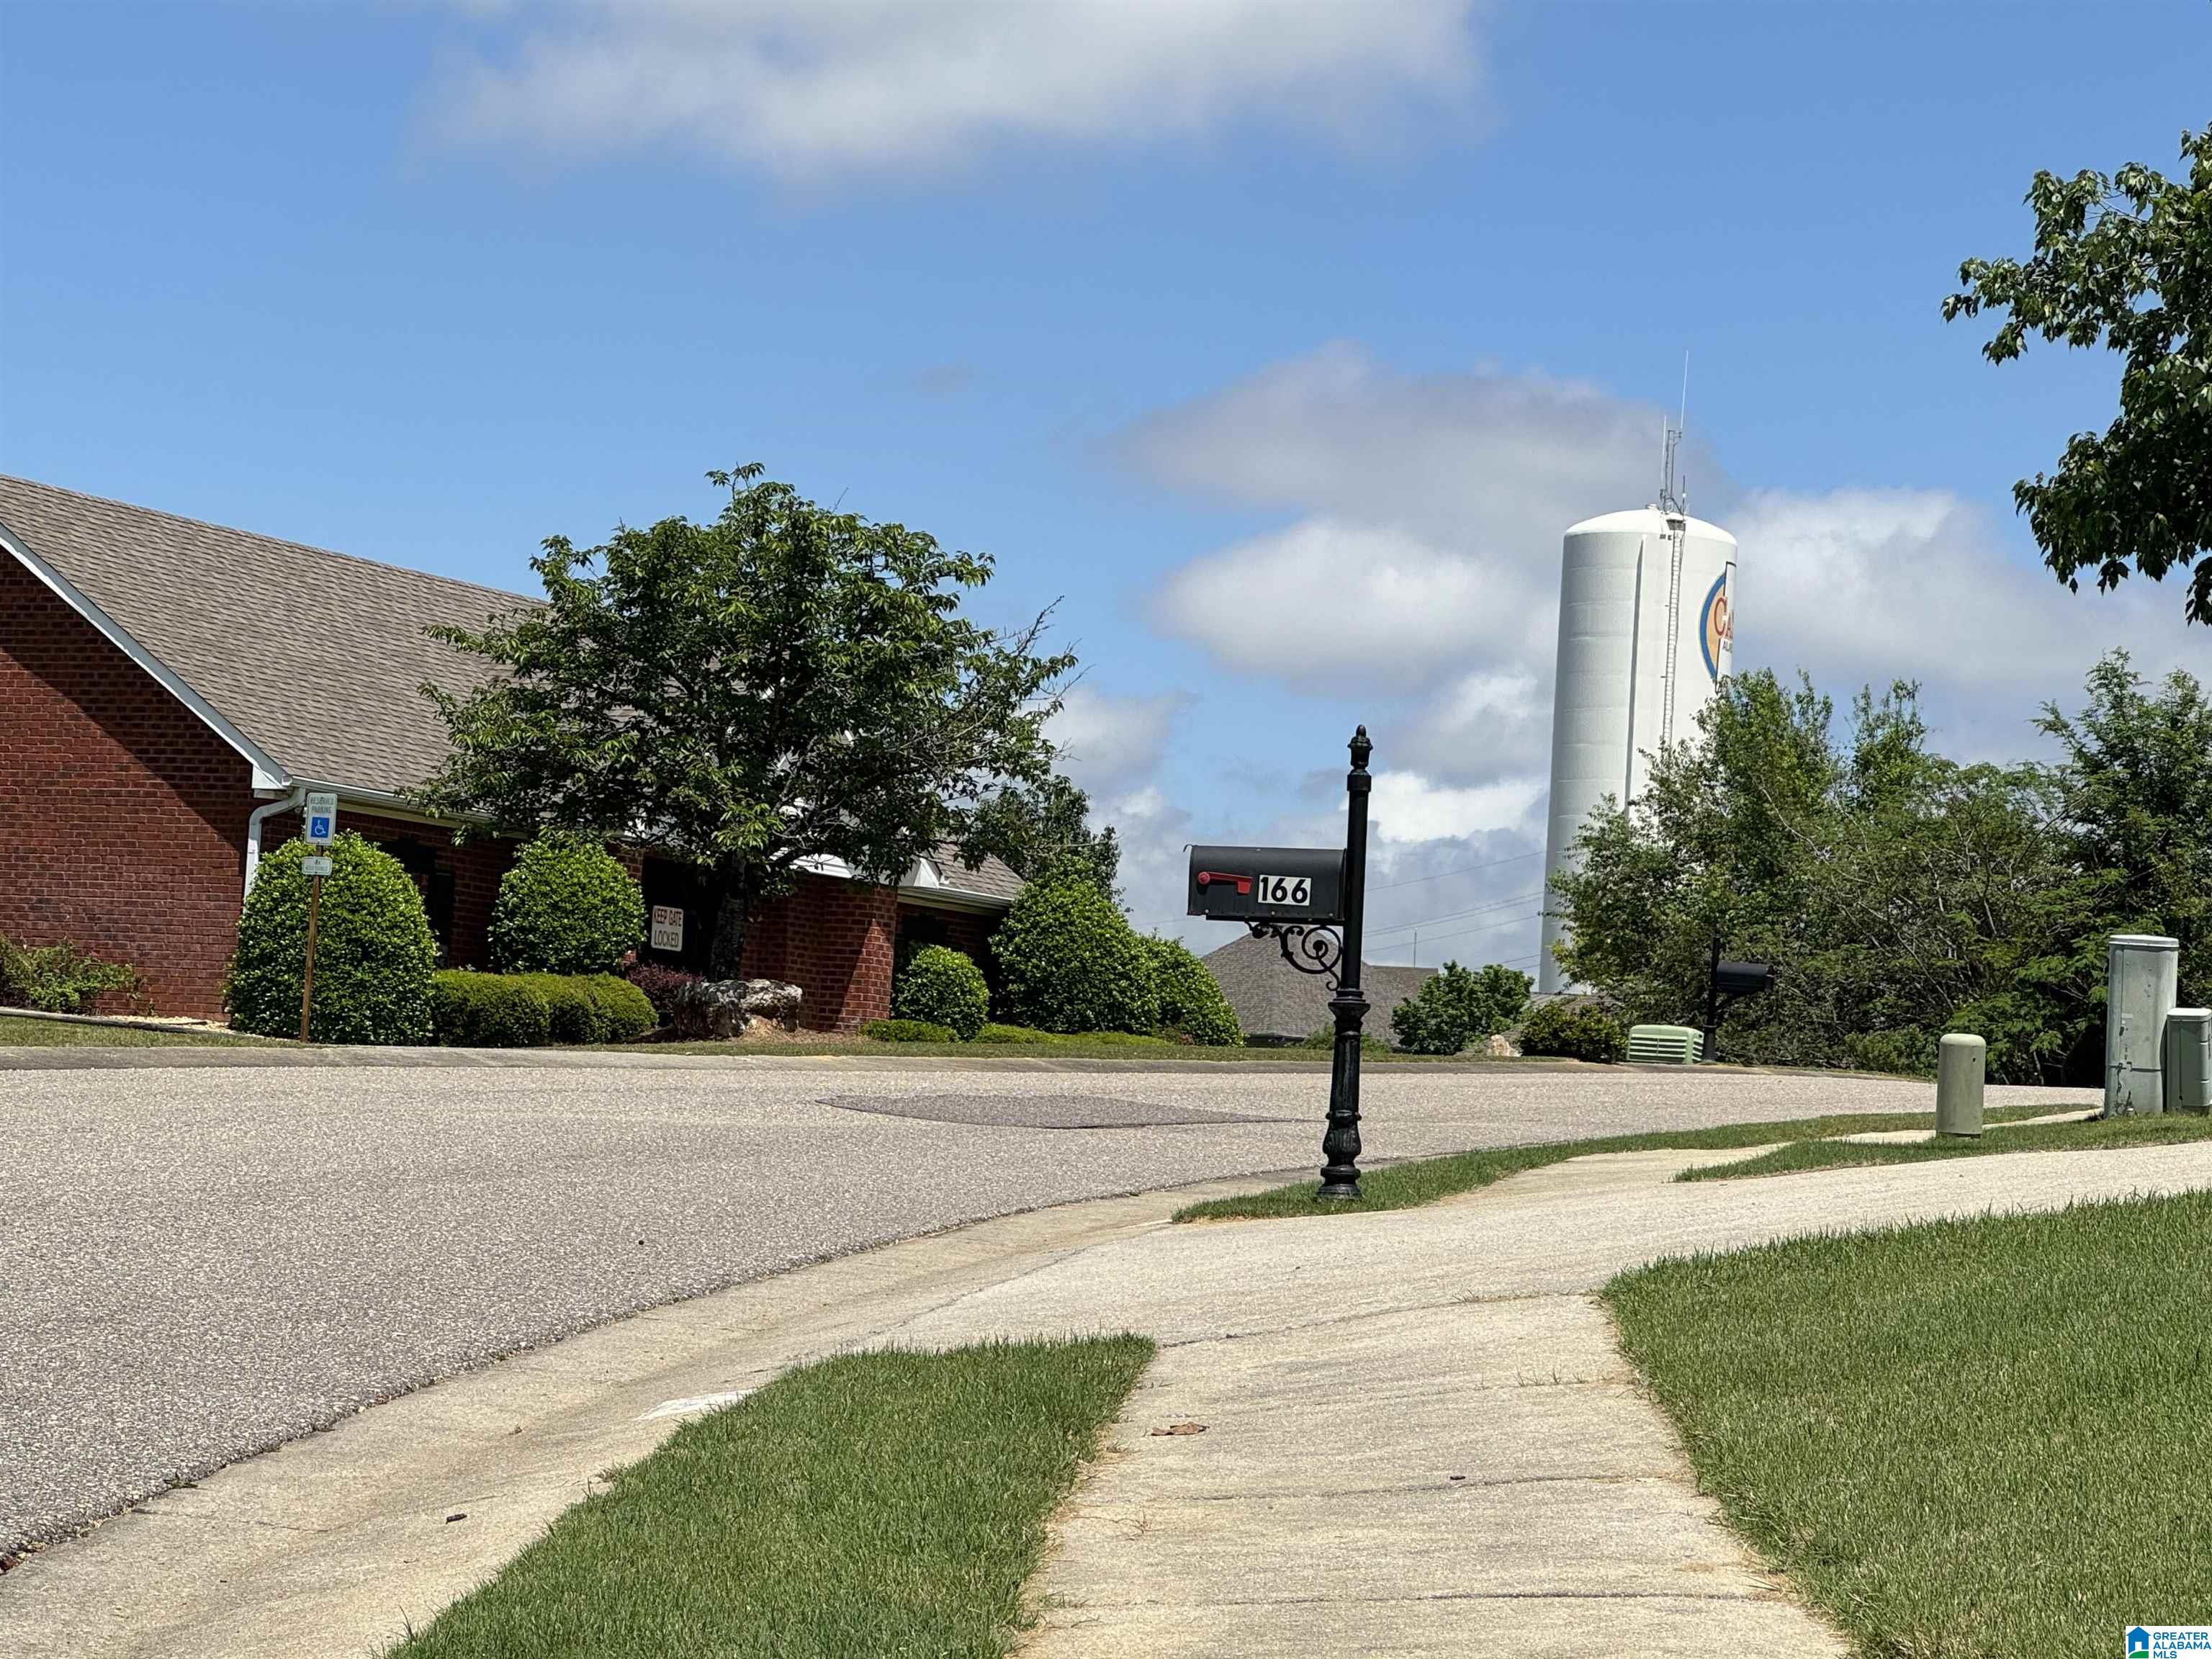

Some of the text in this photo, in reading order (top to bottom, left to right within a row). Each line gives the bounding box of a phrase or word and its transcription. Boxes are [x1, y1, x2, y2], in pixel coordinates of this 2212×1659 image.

[1260, 876, 1308, 904] 166
[654, 908, 682, 927] KEEP GATE
[654, 930, 679, 948] LOCKED
